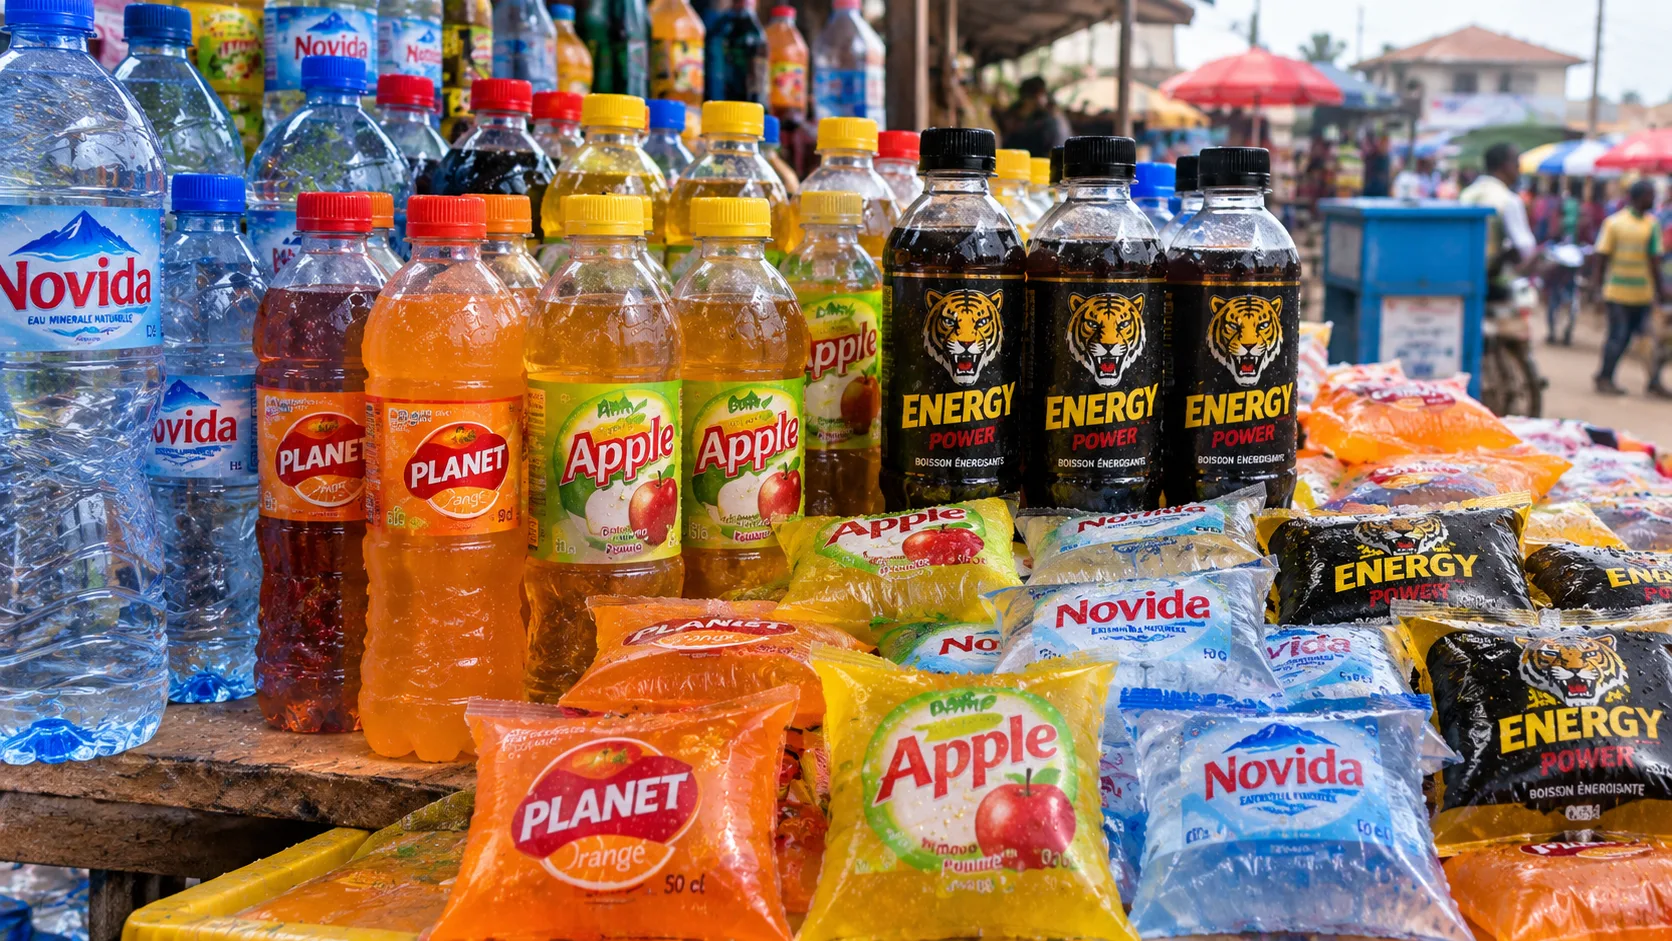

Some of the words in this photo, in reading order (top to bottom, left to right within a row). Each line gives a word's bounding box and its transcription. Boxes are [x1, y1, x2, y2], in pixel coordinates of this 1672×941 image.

[294, 34, 367, 60] Novida
[0, 256, 151, 311] Novida
[27, 316, 46, 326] EAU
[902, 382, 1016, 429] ENERGY
[1045, 383, 1158, 430] ENERGY
[1185, 383, 1293, 430] ENERGY
[151, 409, 238, 446] ovida
[693, 411, 799, 478] Apple
[929, 426, 995, 451] POWER
[1072, 427, 1138, 452] POWER
[1211, 424, 1275, 448] POWER
[411, 444, 506, 489] PLANET
[560, 415, 674, 487] Apple
[915, 457, 952, 467] BOISSON
[1058, 458, 1095, 468] BOISSON
[823, 507, 966, 550] Apple
[1335, 553, 1479, 593] ENERGY
[938, 635, 1000, 656] No
[1498, 705, 1664, 755] ENERGY
[872, 714, 1058, 808] Apple
[1204, 747, 1364, 801] Novida
[1540, 745, 1636, 776] POWER
[519, 771, 690, 843] PLANET
[664, 873, 685, 894] 50
[690, 873, 706, 894] cl
